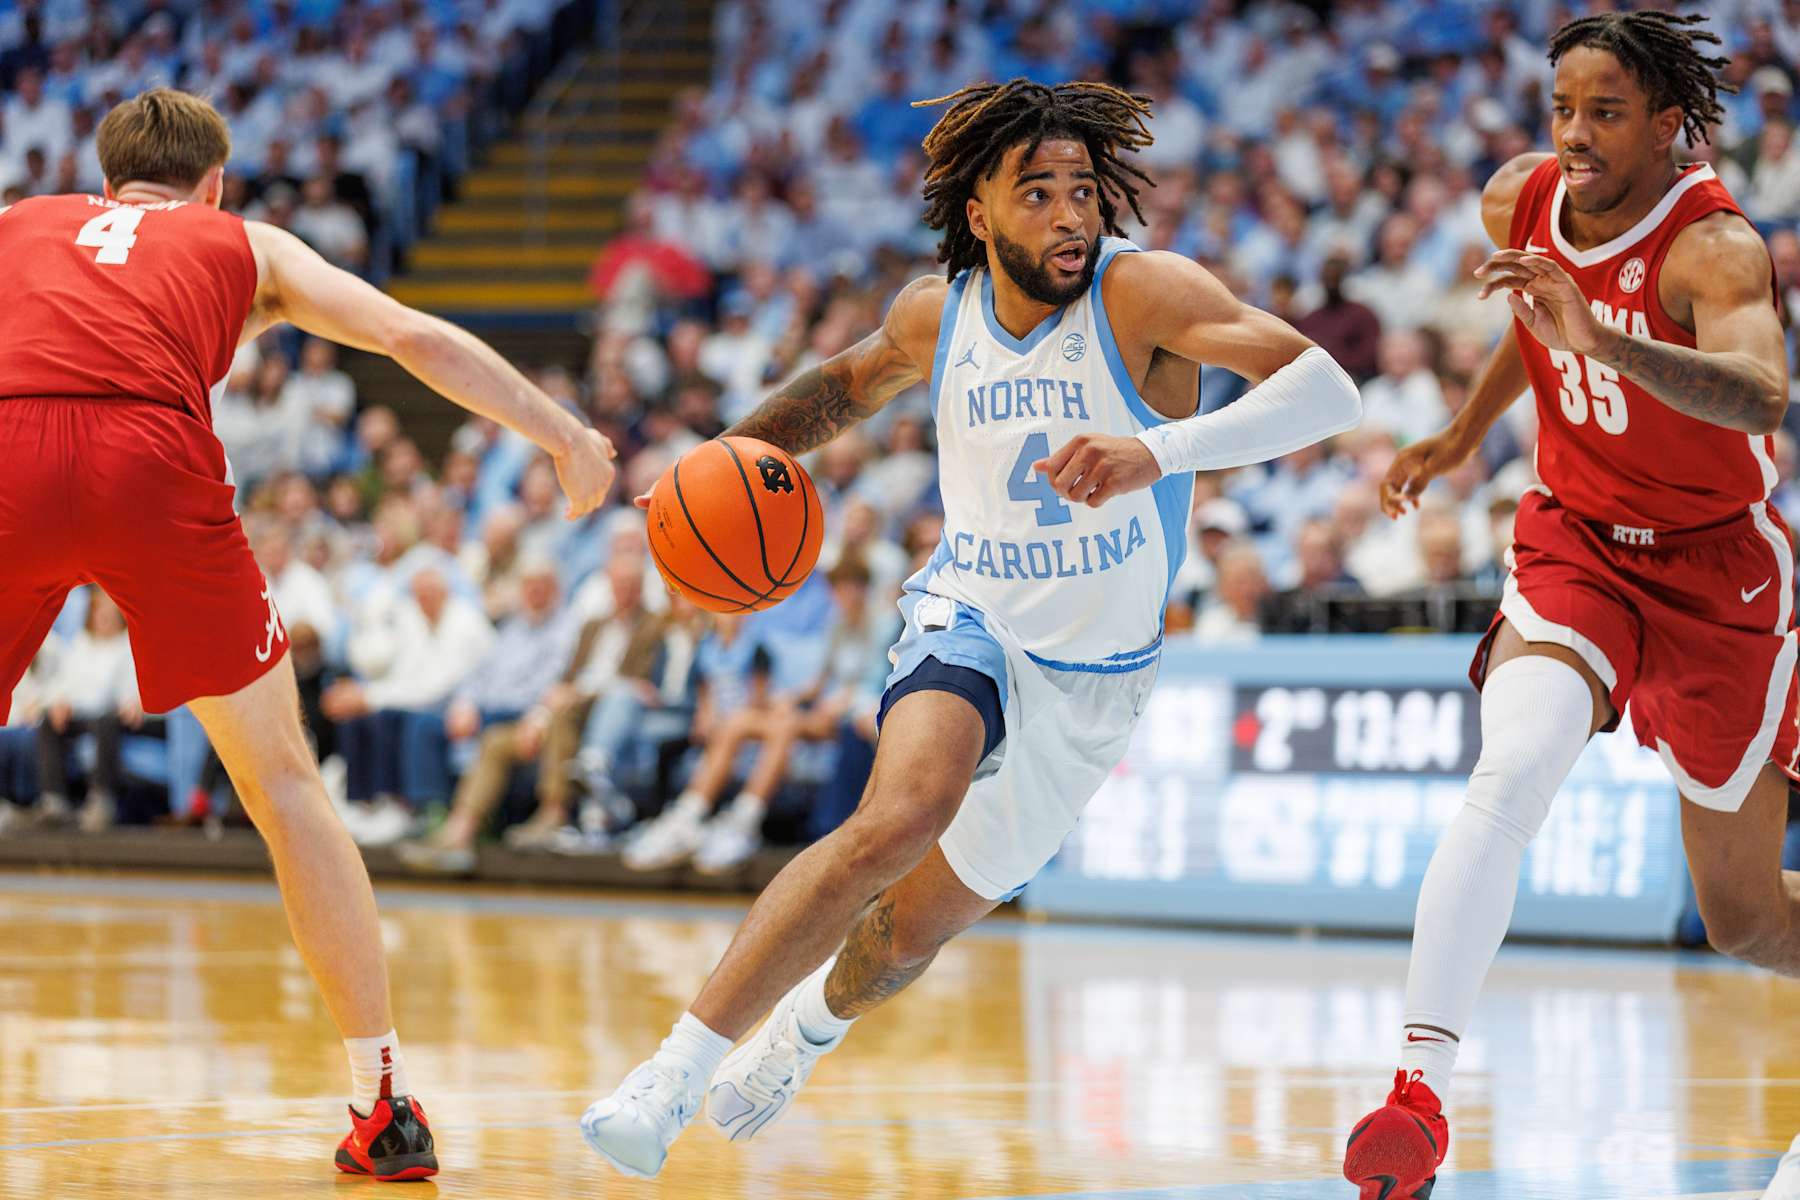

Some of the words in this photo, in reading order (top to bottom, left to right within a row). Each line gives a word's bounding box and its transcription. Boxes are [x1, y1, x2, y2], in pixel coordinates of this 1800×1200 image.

[75, 206, 146, 265] 4
[1619, 258, 1645, 292] SEC
[967, 378, 1090, 428] NORTH
[1549, 348, 1628, 435] 35
[1007, 432, 1072, 527] 4
[954, 515, 1146, 580] CAROLINA
[1613, 523, 1655, 545] RTR
